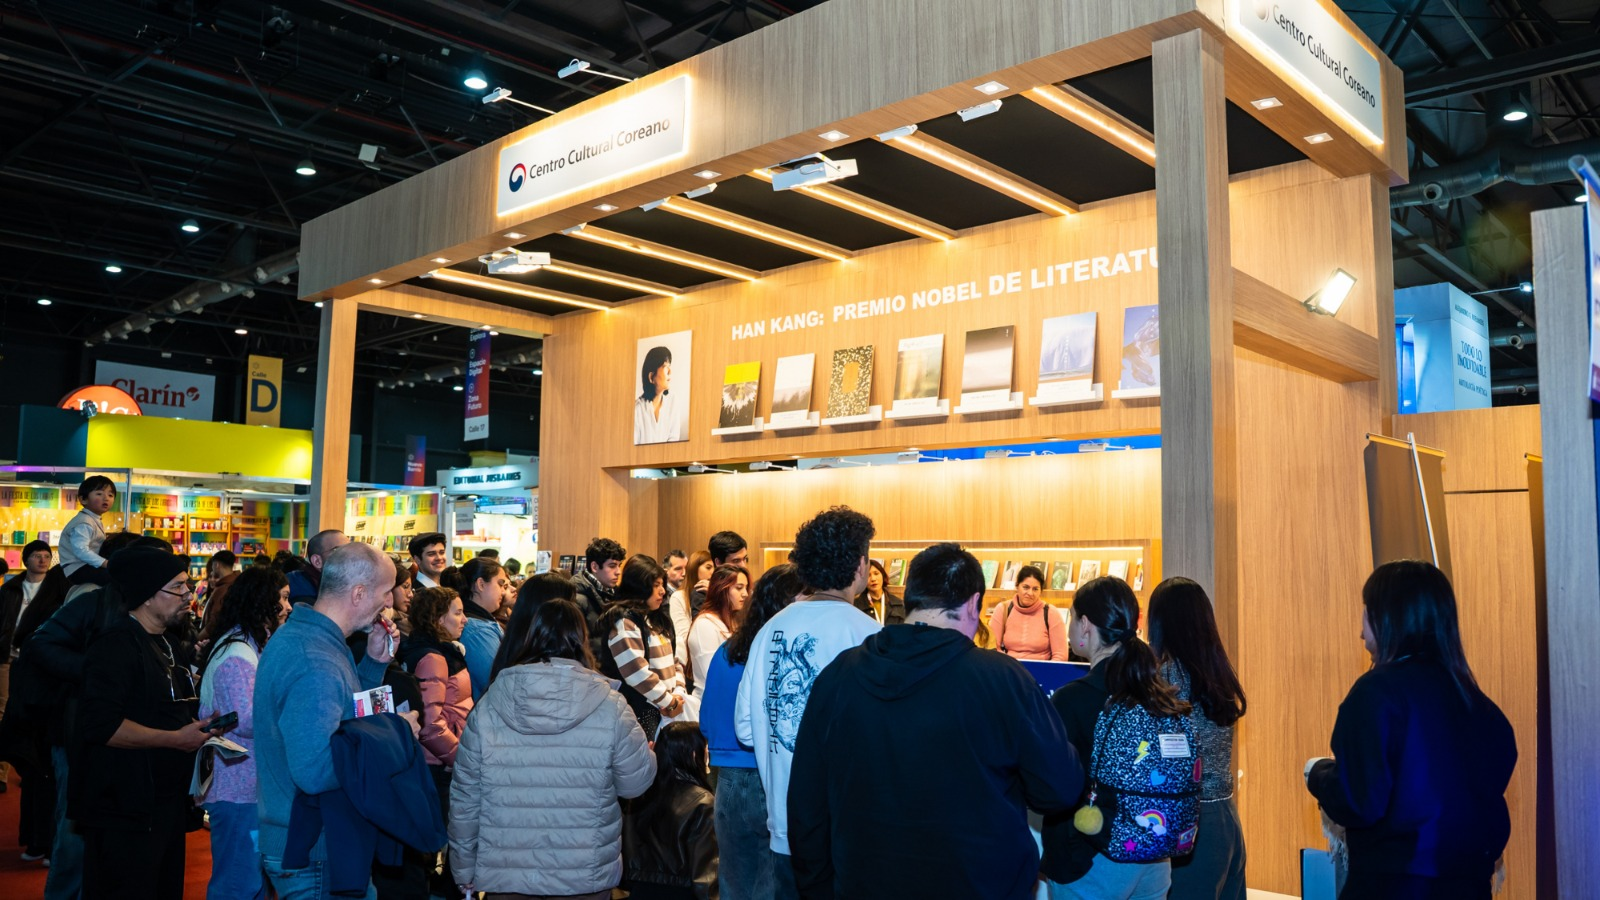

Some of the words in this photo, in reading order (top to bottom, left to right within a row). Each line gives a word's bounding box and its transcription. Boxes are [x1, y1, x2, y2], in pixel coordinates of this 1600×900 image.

[1273, 5, 1306, 46] Centro
[1307, 34, 1342, 79] Cultural
[1342, 67, 1376, 108] Coreano
[529, 156, 566, 179] Centro
[567, 134, 614, 165] Cultural
[617, 118, 671, 147] Coreano
[731, 320, 766, 341] HAN
[770, 310, 825, 335] KANG:
[833, 294, 906, 322] PREMIO
[912, 281, 982, 310] NOBEL
[988, 271, 1022, 296] DE
[1457, 353, 1487, 378] INOLVIDABLE
[1461, 340, 1475, 358] TODO
[1475, 348, 1482, 362] LO
[250, 378, 278, 413] D
[468, 395, 480, 403] Zona
[468, 425, 479, 433] Calle
